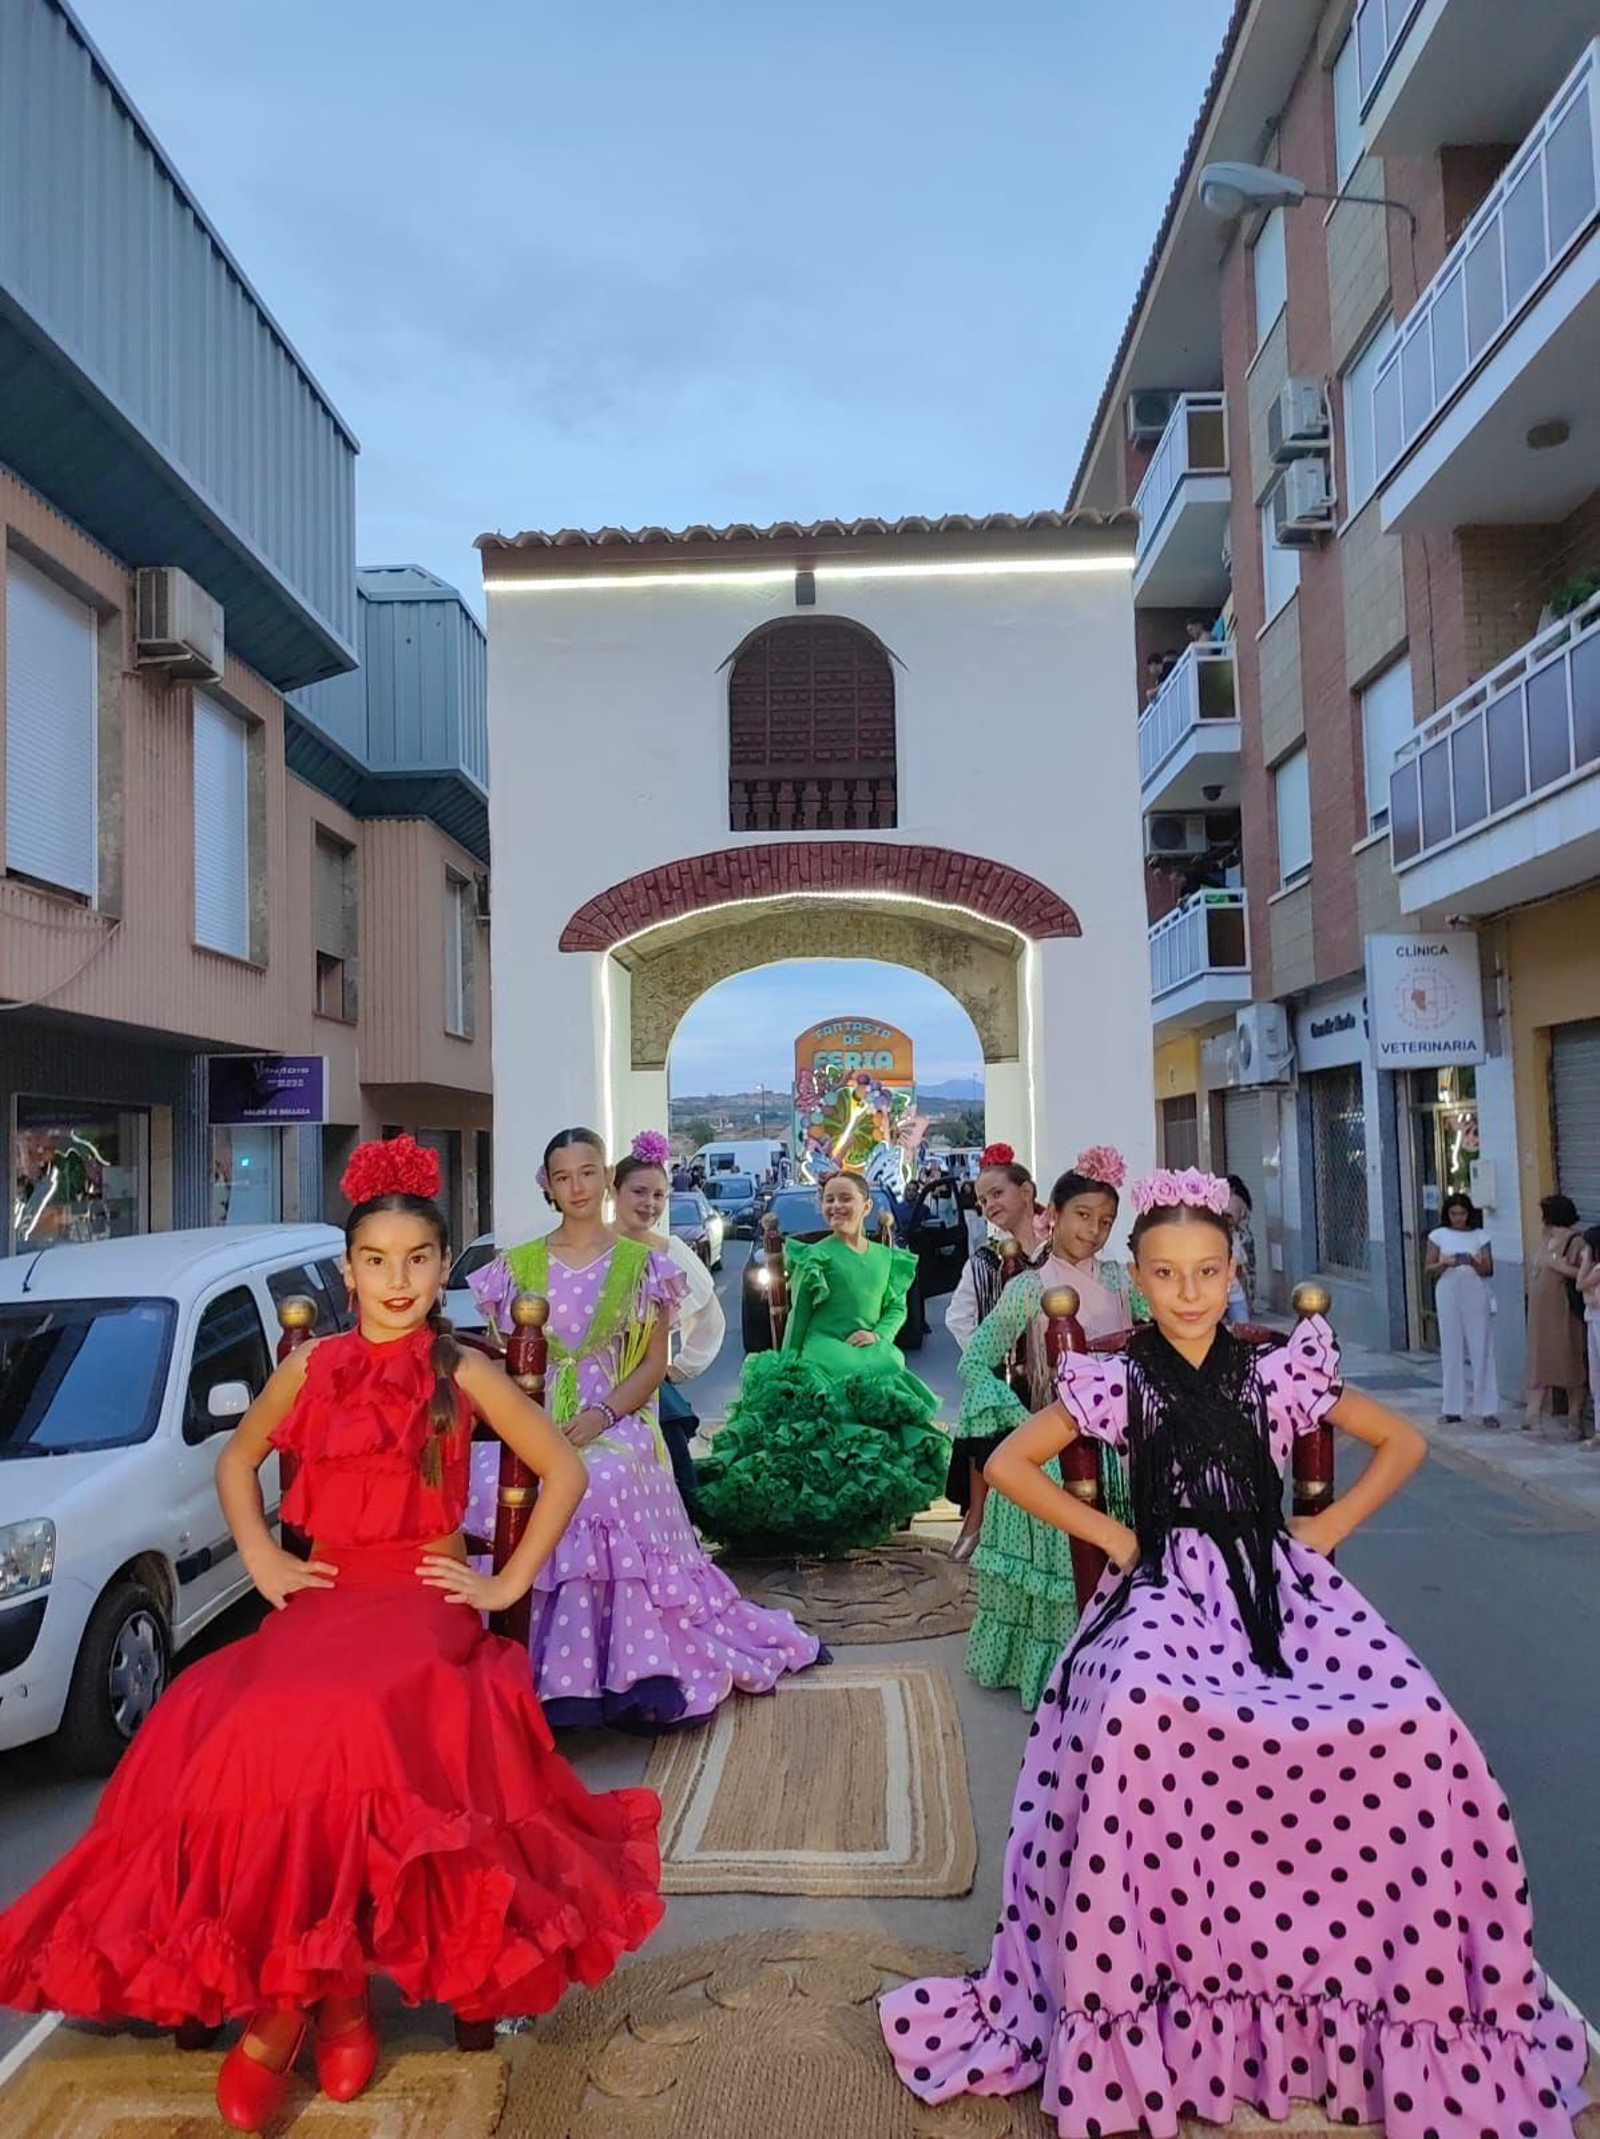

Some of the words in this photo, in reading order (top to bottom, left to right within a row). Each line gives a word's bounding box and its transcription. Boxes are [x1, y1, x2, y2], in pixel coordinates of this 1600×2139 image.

[1396, 944, 1450, 958] CLÍNICA
[843, 1035, 863, 1045] DE
[1381, 1039, 1477, 1055] VETERINARIA
[813, 1050, 894, 1070] FERIA
[279, 1107, 311, 1115] BELLEZA
